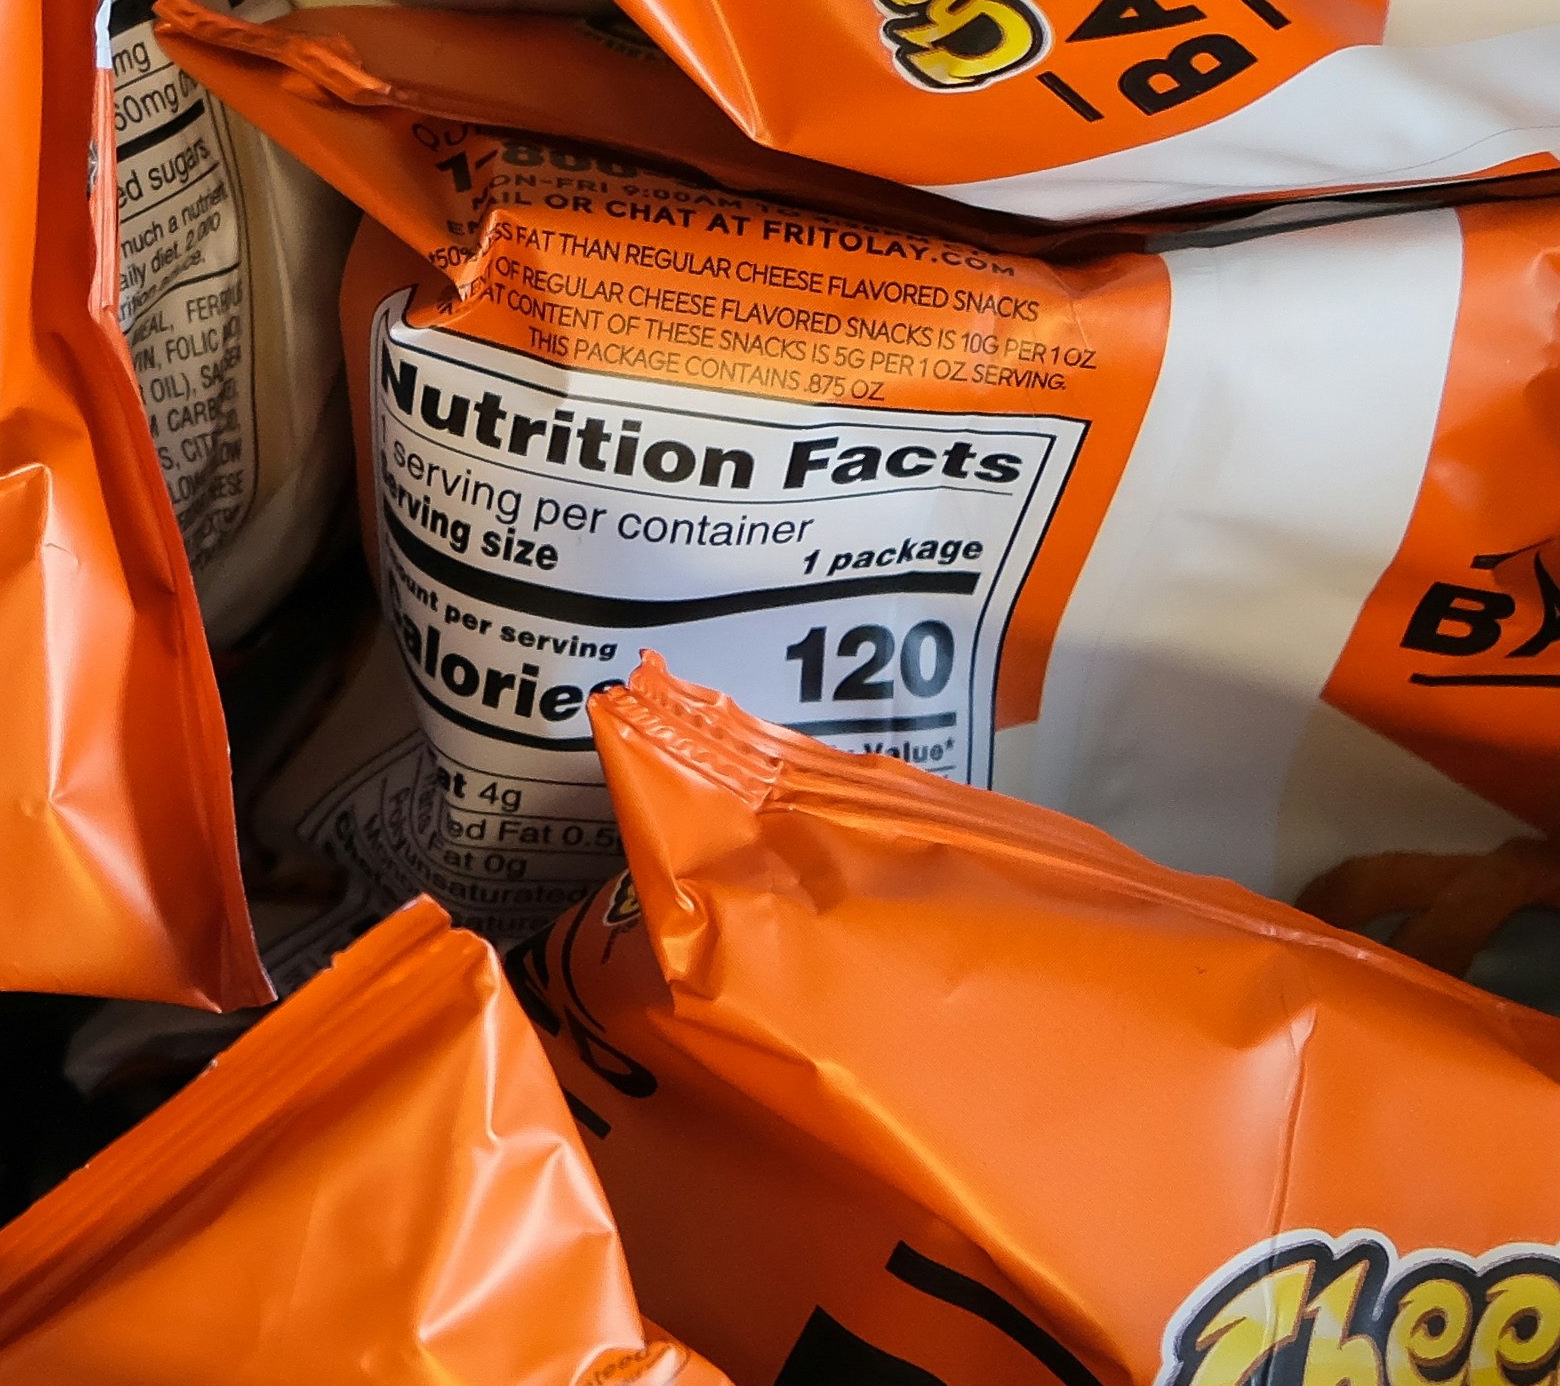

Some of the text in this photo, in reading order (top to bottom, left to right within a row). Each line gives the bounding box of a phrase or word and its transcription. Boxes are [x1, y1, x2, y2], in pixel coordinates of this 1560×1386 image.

[523, 227, 1040, 322] FAT THAN REGULAR CHEESE FLAVORED SNACKS
[549, 193, 1016, 277] OR CHAT AT FRITOLAY.COM
[381, 357, 1025, 491] Nutrition Facts
[394, 444, 814, 545] serving per container
[801, 535, 986, 575] 1 package
[786, 619, 956, 704] 120
